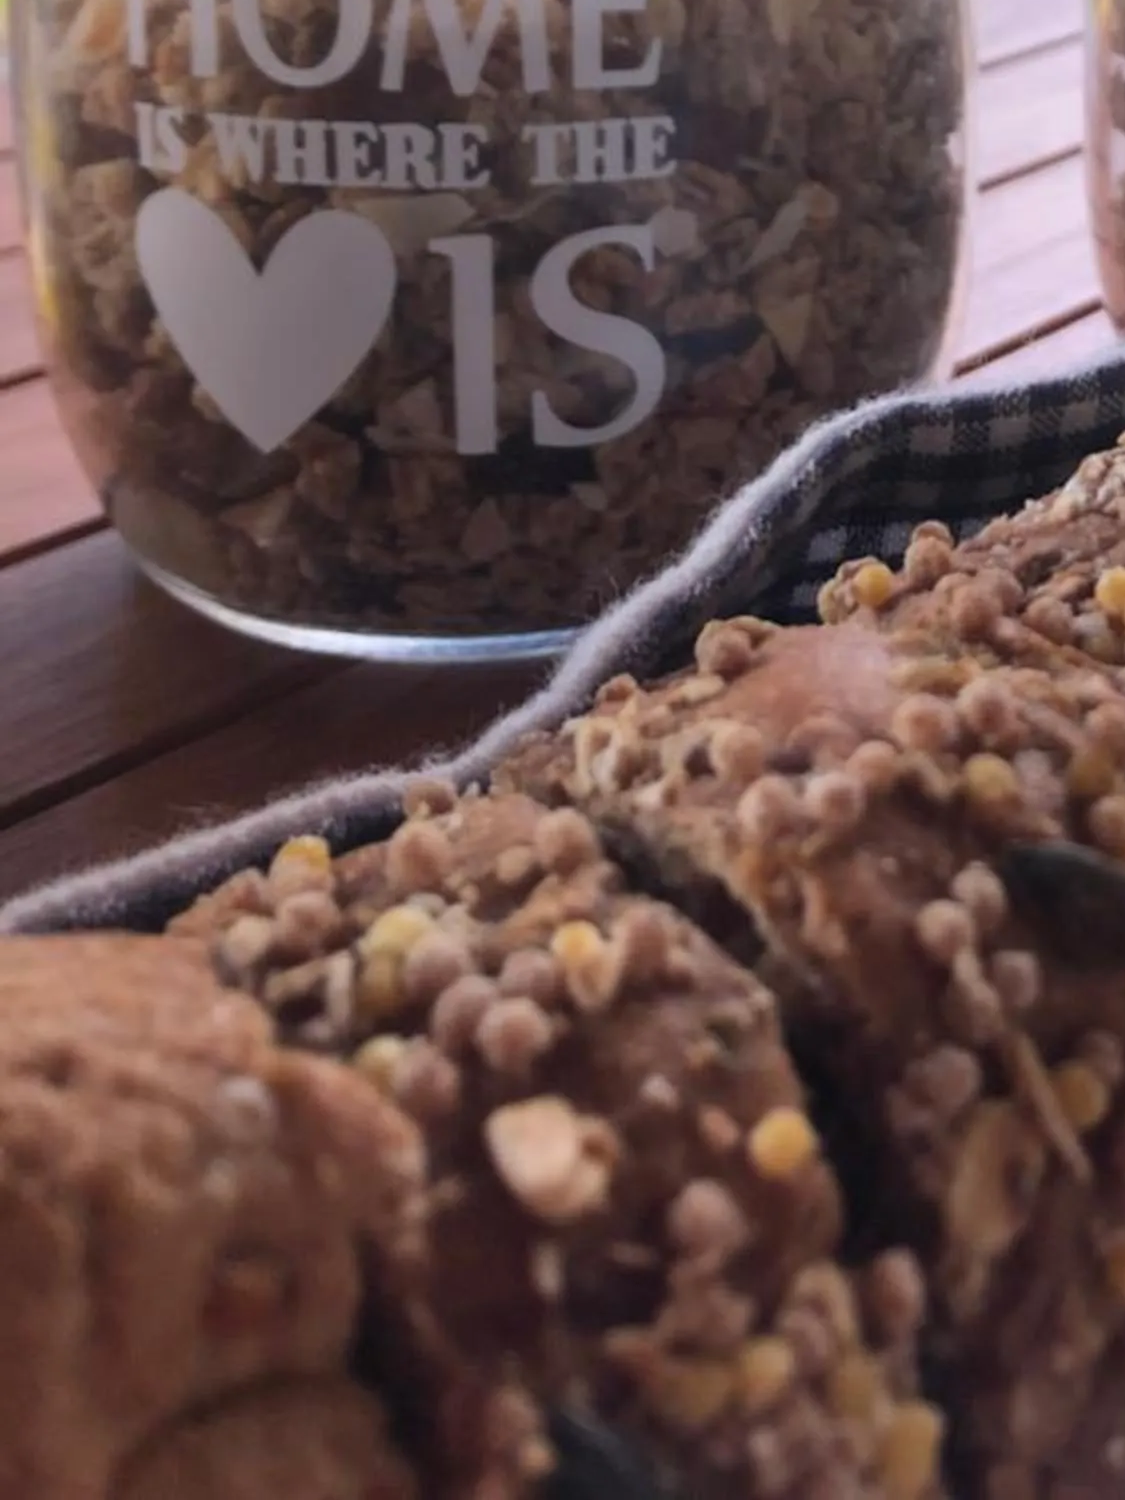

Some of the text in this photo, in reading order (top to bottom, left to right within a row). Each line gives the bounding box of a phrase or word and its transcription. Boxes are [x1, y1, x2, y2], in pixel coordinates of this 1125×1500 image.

[134, 102, 677, 189] IS WHERE THE
[428, 223, 667, 456] IS
